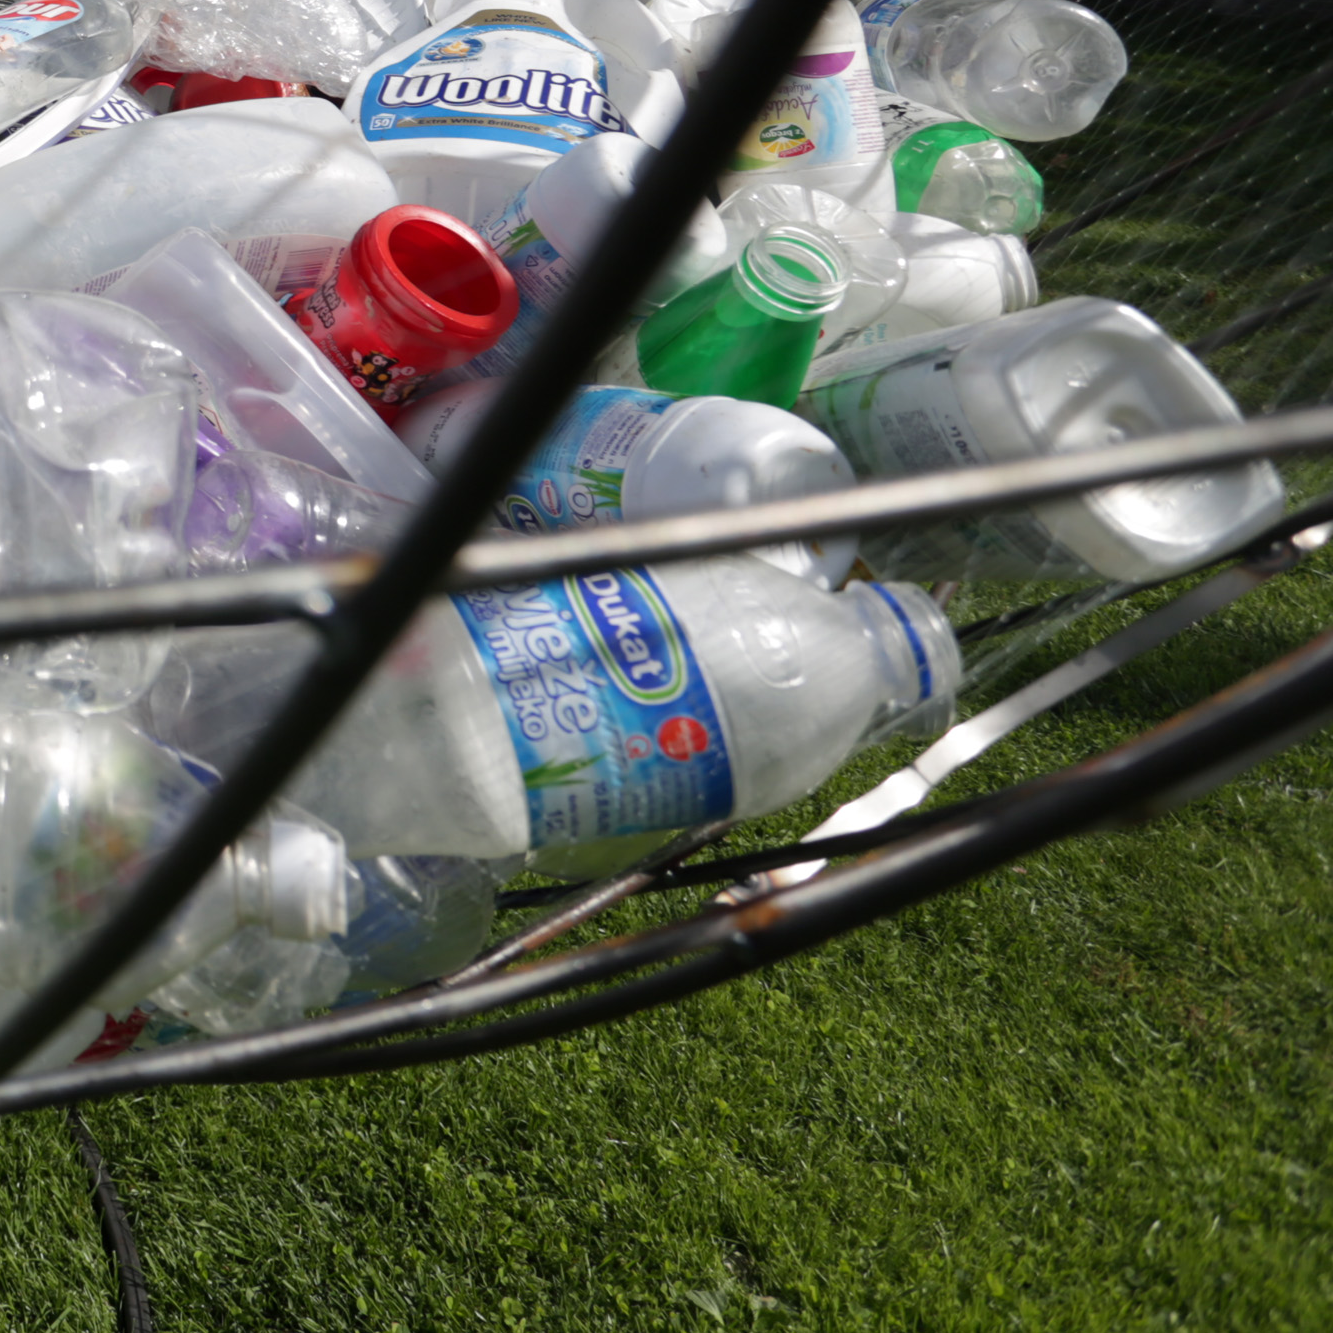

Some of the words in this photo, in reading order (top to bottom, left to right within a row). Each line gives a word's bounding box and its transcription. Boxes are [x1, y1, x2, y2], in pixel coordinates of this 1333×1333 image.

[513, 18, 546, 26] NEW
[377, 69, 625, 134] Woolite
[372, 117, 393, 129] 50
[417, 118, 448, 126] Extra
[450, 118, 485, 127] White
[487, 119, 541, 132] Brilliance
[583, 571, 665, 681] Dukat
[485, 629, 549, 743] mlijeko
